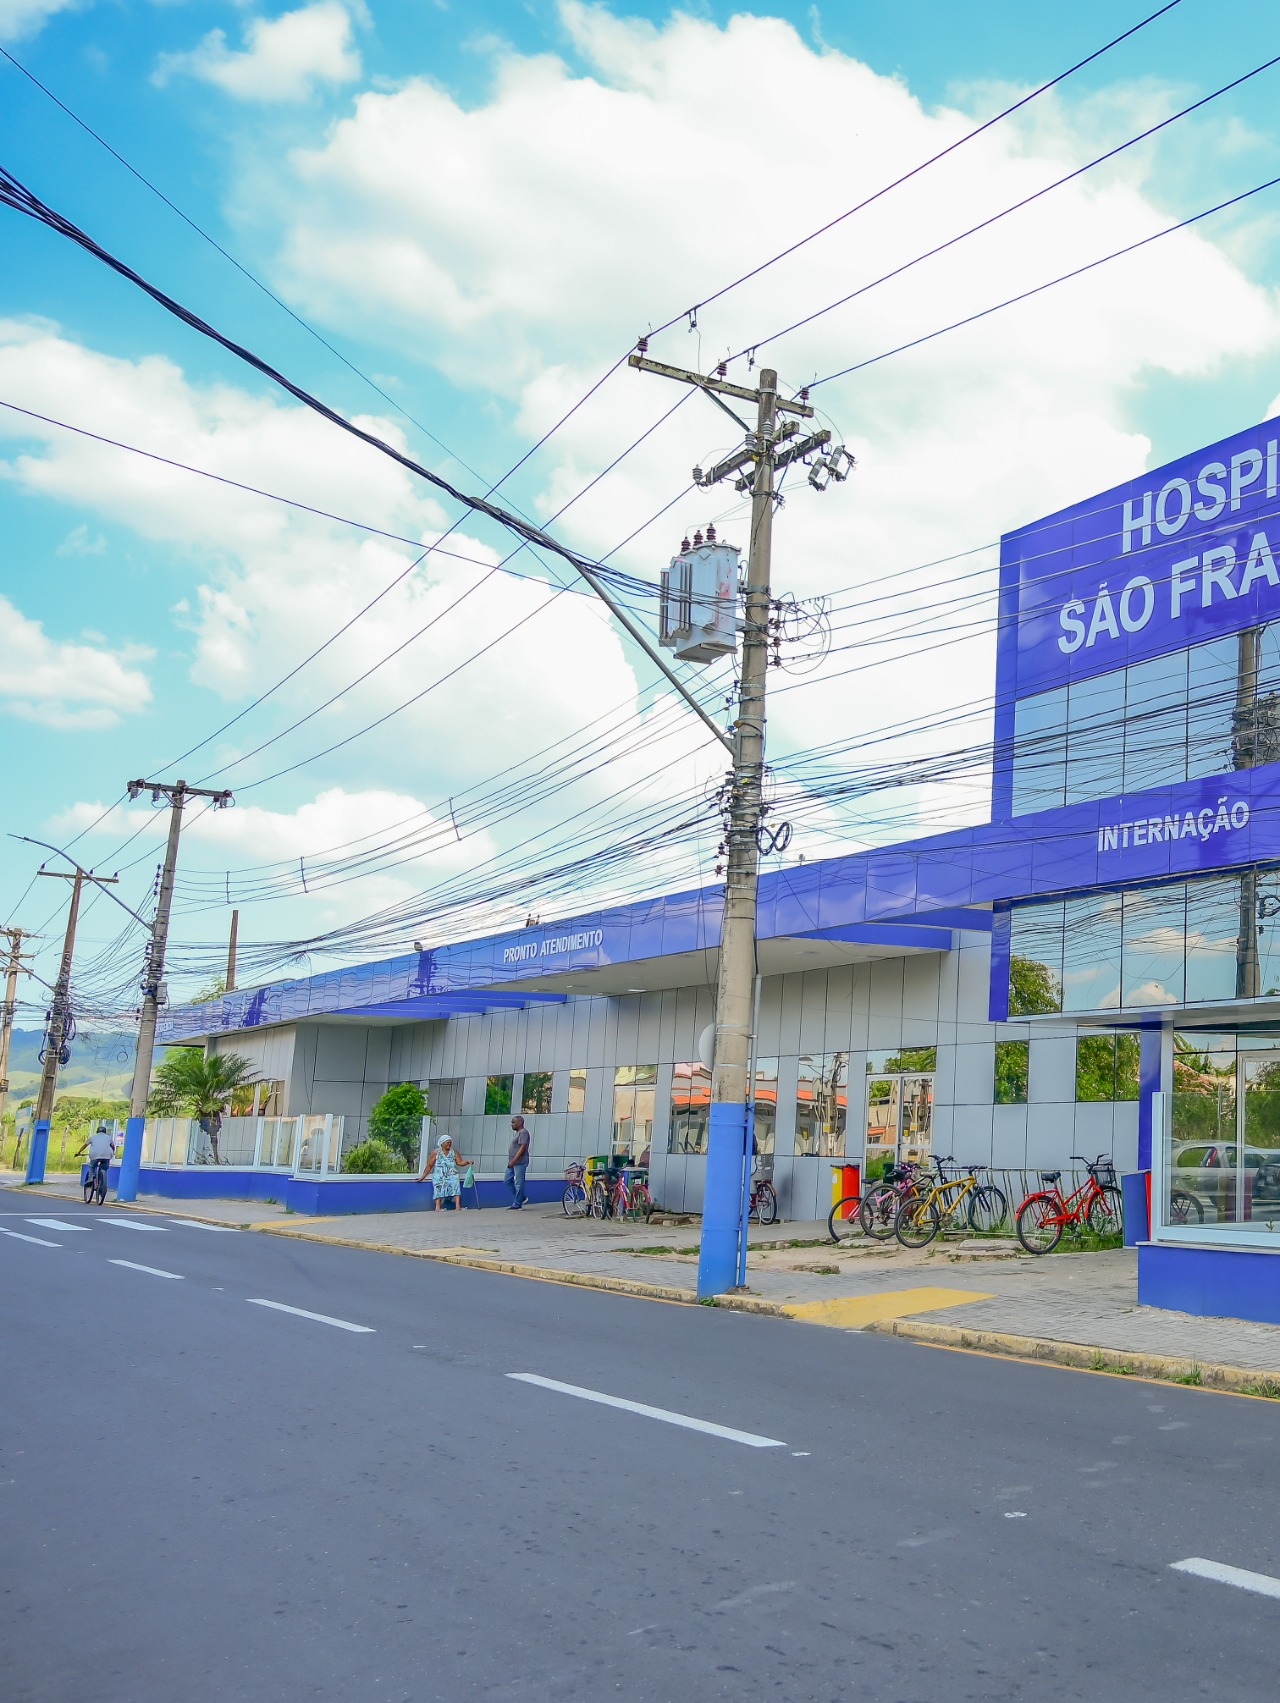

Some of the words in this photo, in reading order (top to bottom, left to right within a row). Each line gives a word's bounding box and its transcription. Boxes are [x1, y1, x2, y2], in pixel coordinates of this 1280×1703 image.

[1057, 577, 1155, 656] SÃO
[1097, 796, 1250, 852] INTERNAÇÃO
[503, 942, 538, 963] PRONTO
[540, 928, 603, 957] ATENDIMENTO
